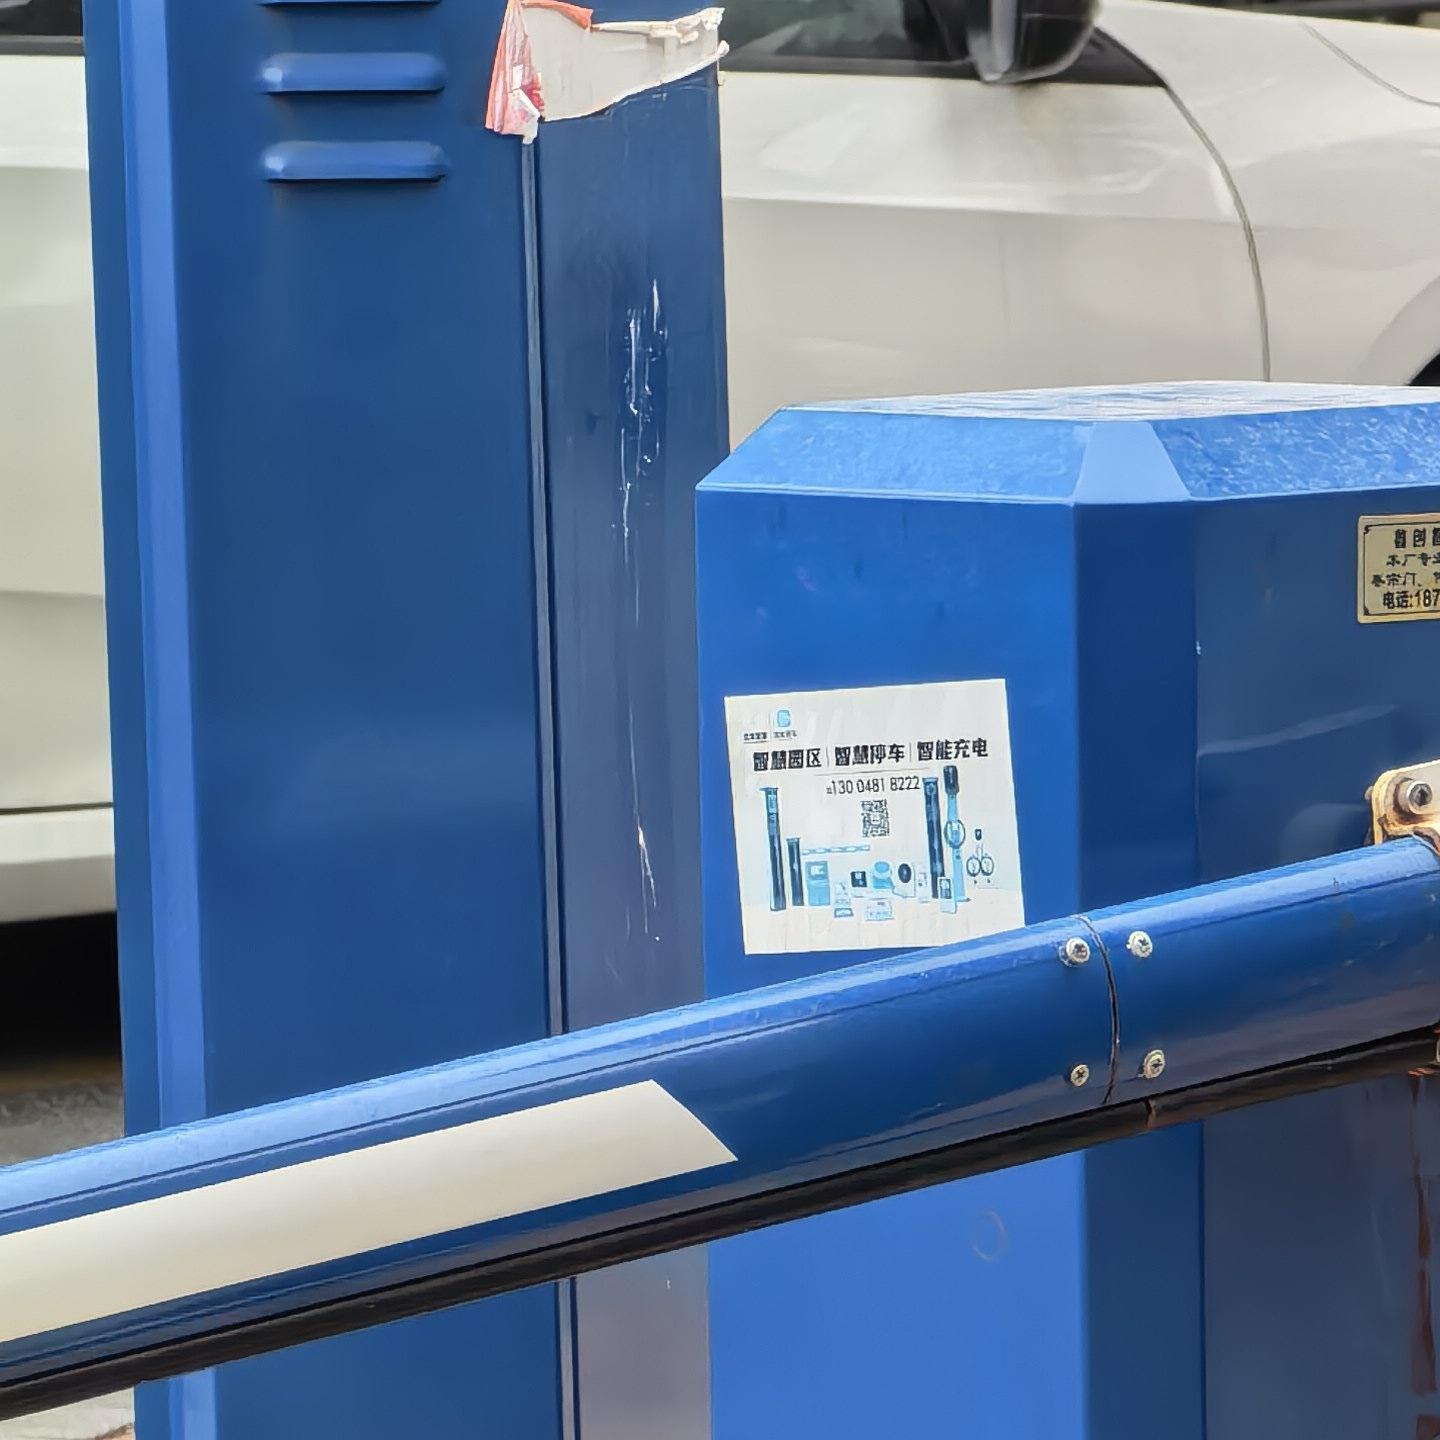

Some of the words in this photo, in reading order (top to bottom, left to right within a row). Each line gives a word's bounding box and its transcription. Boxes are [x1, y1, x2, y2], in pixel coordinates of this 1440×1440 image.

[834, 743, 906, 766] 智慧停车
[917, 737, 989, 761] 智能充电
[856, 777, 885, 792] 0481
[890, 775, 920, 791] 8222
